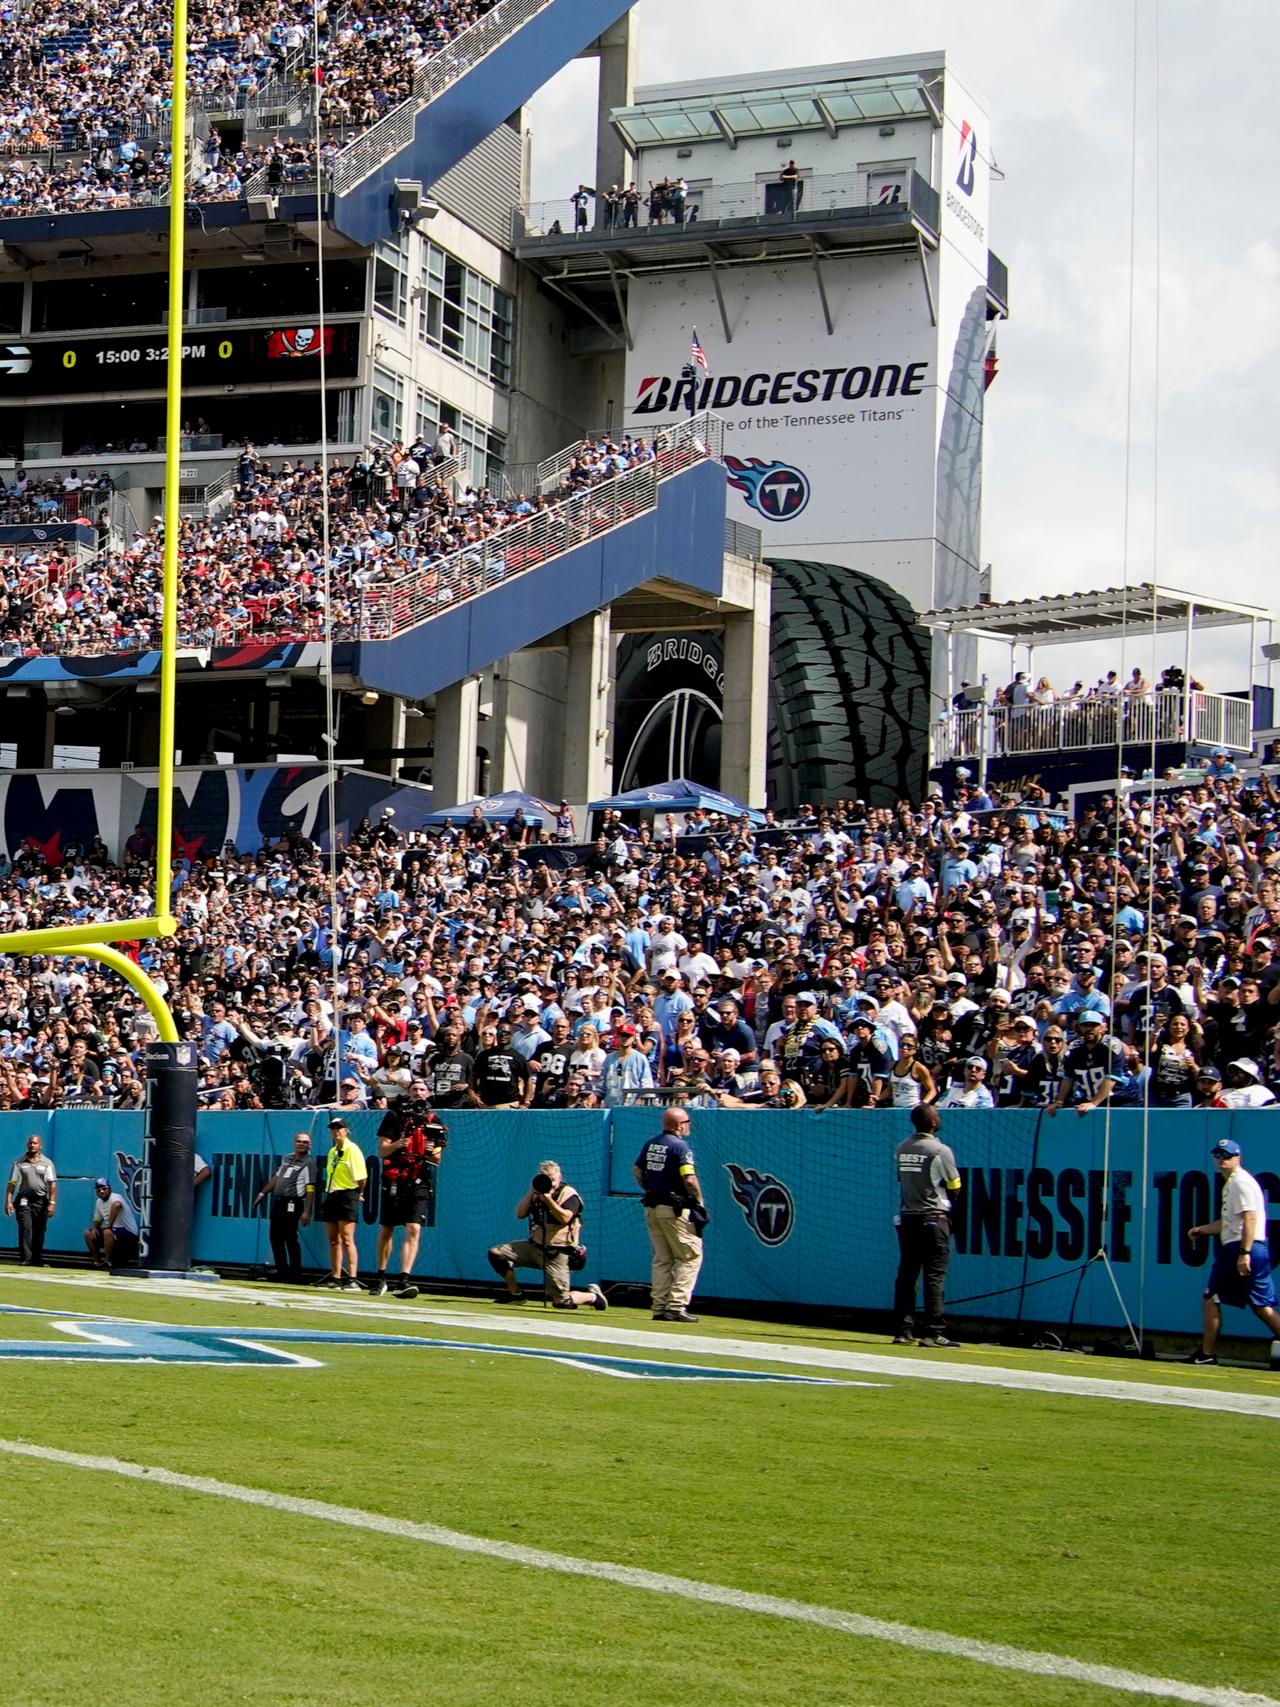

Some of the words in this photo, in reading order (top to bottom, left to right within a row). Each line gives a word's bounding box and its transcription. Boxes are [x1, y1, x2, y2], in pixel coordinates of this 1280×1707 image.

[62, 351, 77, 368] 0
[95, 349, 141, 364] 15:00
[145, 347, 169, 361] 3:2
[181, 345, 206, 359] PM
[218, 341, 233, 359] 0
[632, 362, 929, 414] BRIDGESTONE
[738, 419, 753, 430] of
[756, 416, 779, 428] the
[783, 412, 856, 426] Tennessee
[860, 409, 903, 421] Titans
[1230, 1009, 1246, 1032] 4
[899, 1153, 928, 1163] BEST
